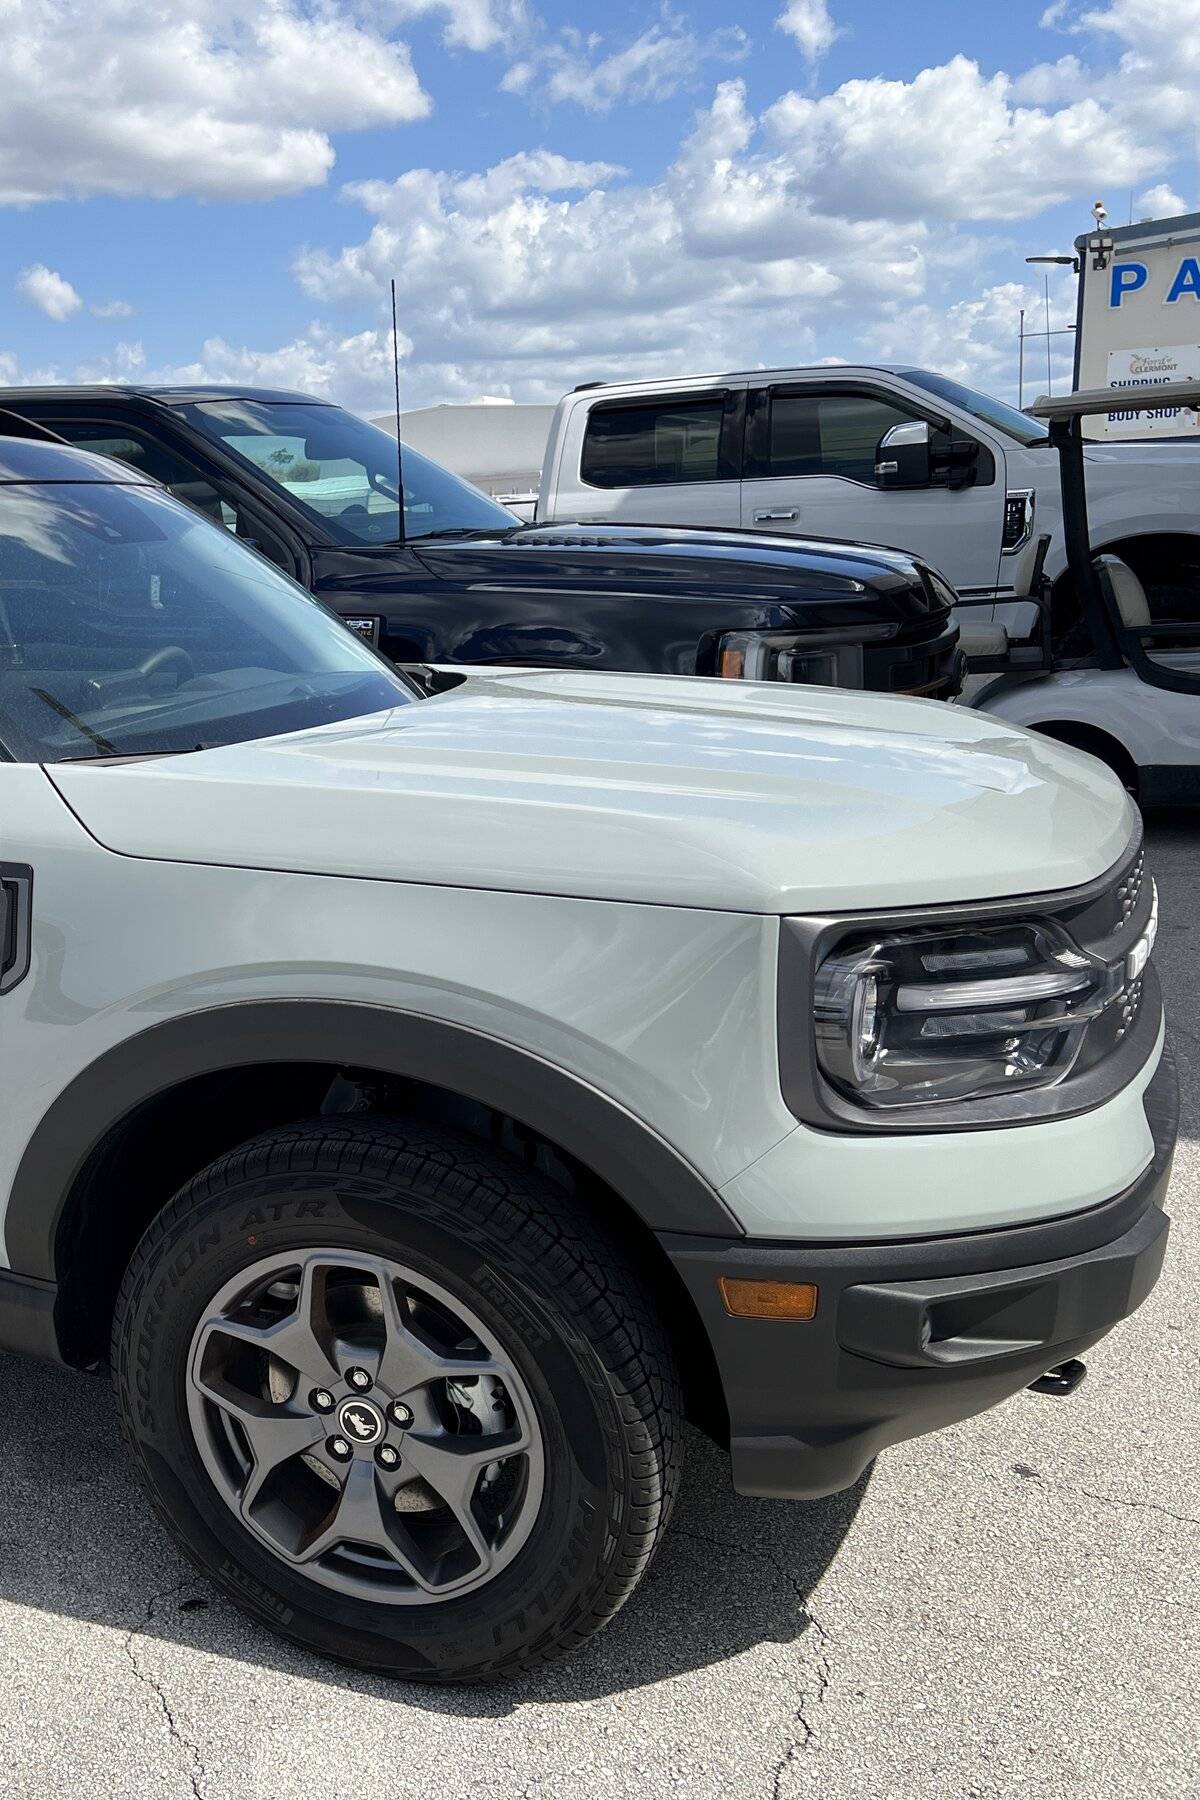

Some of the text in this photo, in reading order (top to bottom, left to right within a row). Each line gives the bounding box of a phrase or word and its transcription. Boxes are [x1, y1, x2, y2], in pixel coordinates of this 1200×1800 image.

[1135, 363, 1177, 372] CLERMONT
[1108, 407, 1181, 421] BODY SHOP
[136, 1198, 329, 1432] SCORPION ATR
[471, 1263, 553, 1348] PIRELLI
